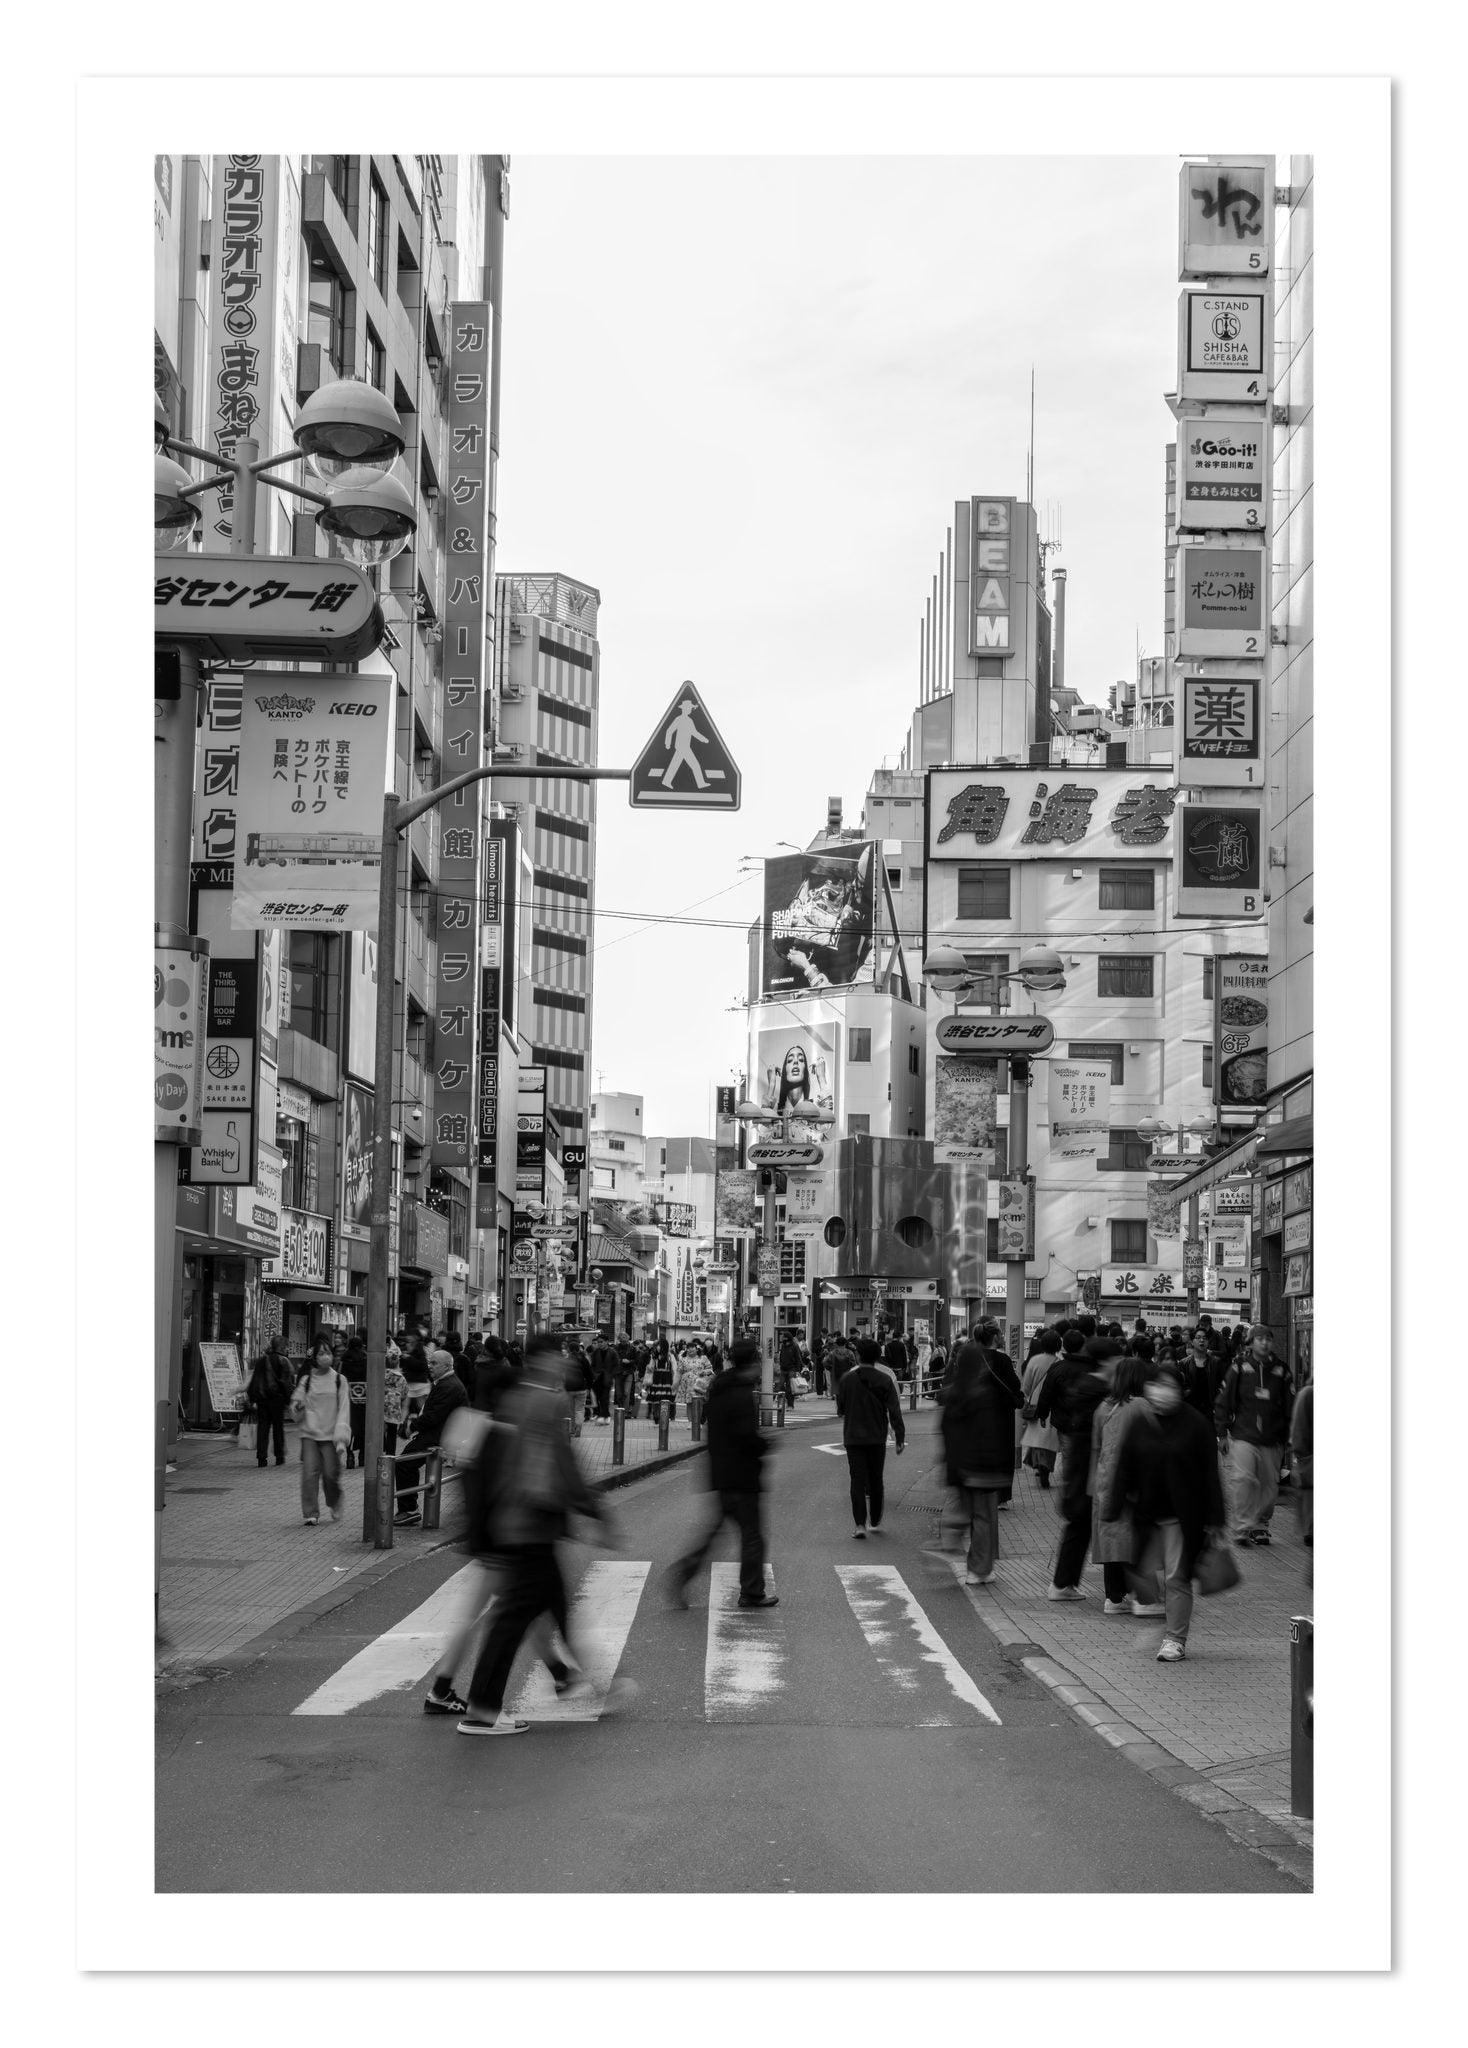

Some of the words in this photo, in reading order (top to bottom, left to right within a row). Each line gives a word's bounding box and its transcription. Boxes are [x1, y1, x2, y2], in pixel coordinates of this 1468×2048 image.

[222, 167, 264, 308] カラオケ
[1248, 253, 1261, 269] 5
[1203, 302, 1249, 310] C.STAND
[1203, 342, 1249, 353] SHISHA
[1203, 353, 1249, 362] CAFE&BAR
[1247, 381, 1260, 396] 4
[1202, 440, 1258, 457] Goo-it!
[1195, 460, 1254, 470] 渋谷宇田川町店
[1190, 486, 1259, 498] 全身もみほぐし
[1246, 509, 1258, 525] 3
[977, 502, 1010, 647] BEAM
[1246, 637, 1258, 653] 2
[268, 711, 303, 719] KANTO
[328, 702, 378, 716] KEIO
[1194, 686, 1246, 737] 薬
[1188, 740, 1251, 755] マツモトキヨシ
[273, 738, 290, 782] 冒険へ
[291, 738, 309, 814] カントーの
[312, 739, 330, 814] ポケパーク
[334, 739, 351, 800] 京王線で
[1245, 767, 1254, 782] 1
[1189, 823, 1249, 871] 一蘭
[488, 843, 499, 879] kimono
[488, 884, 498, 919] hearts
[1244, 896, 1256, 912] B
[260, 903, 349, 916] 渋谷センター街
[218, 971, 233, 979] THE
[1223, 976, 1268, 989] 四川料理
[213, 1007, 236, 1015] ROOM
[217, 1018, 232, 1026] BAR
[437, 900, 471, 1144] カラオケ館
[944, 1025, 1047, 1039] 渋谷センター街
[1221, 1033, 1250, 1054] 6F
[166, 1083, 186, 1097] Day!
[230, 1095, 247, 1103] BAR
[202, 1148, 235, 1160] Whisky
[564, 1151, 585, 1163] GU
[201, 1158, 222, 1167] Bank
[1115, 1271, 1174, 1294] 兆楽
[684, 1271, 693, 1313] BEER
